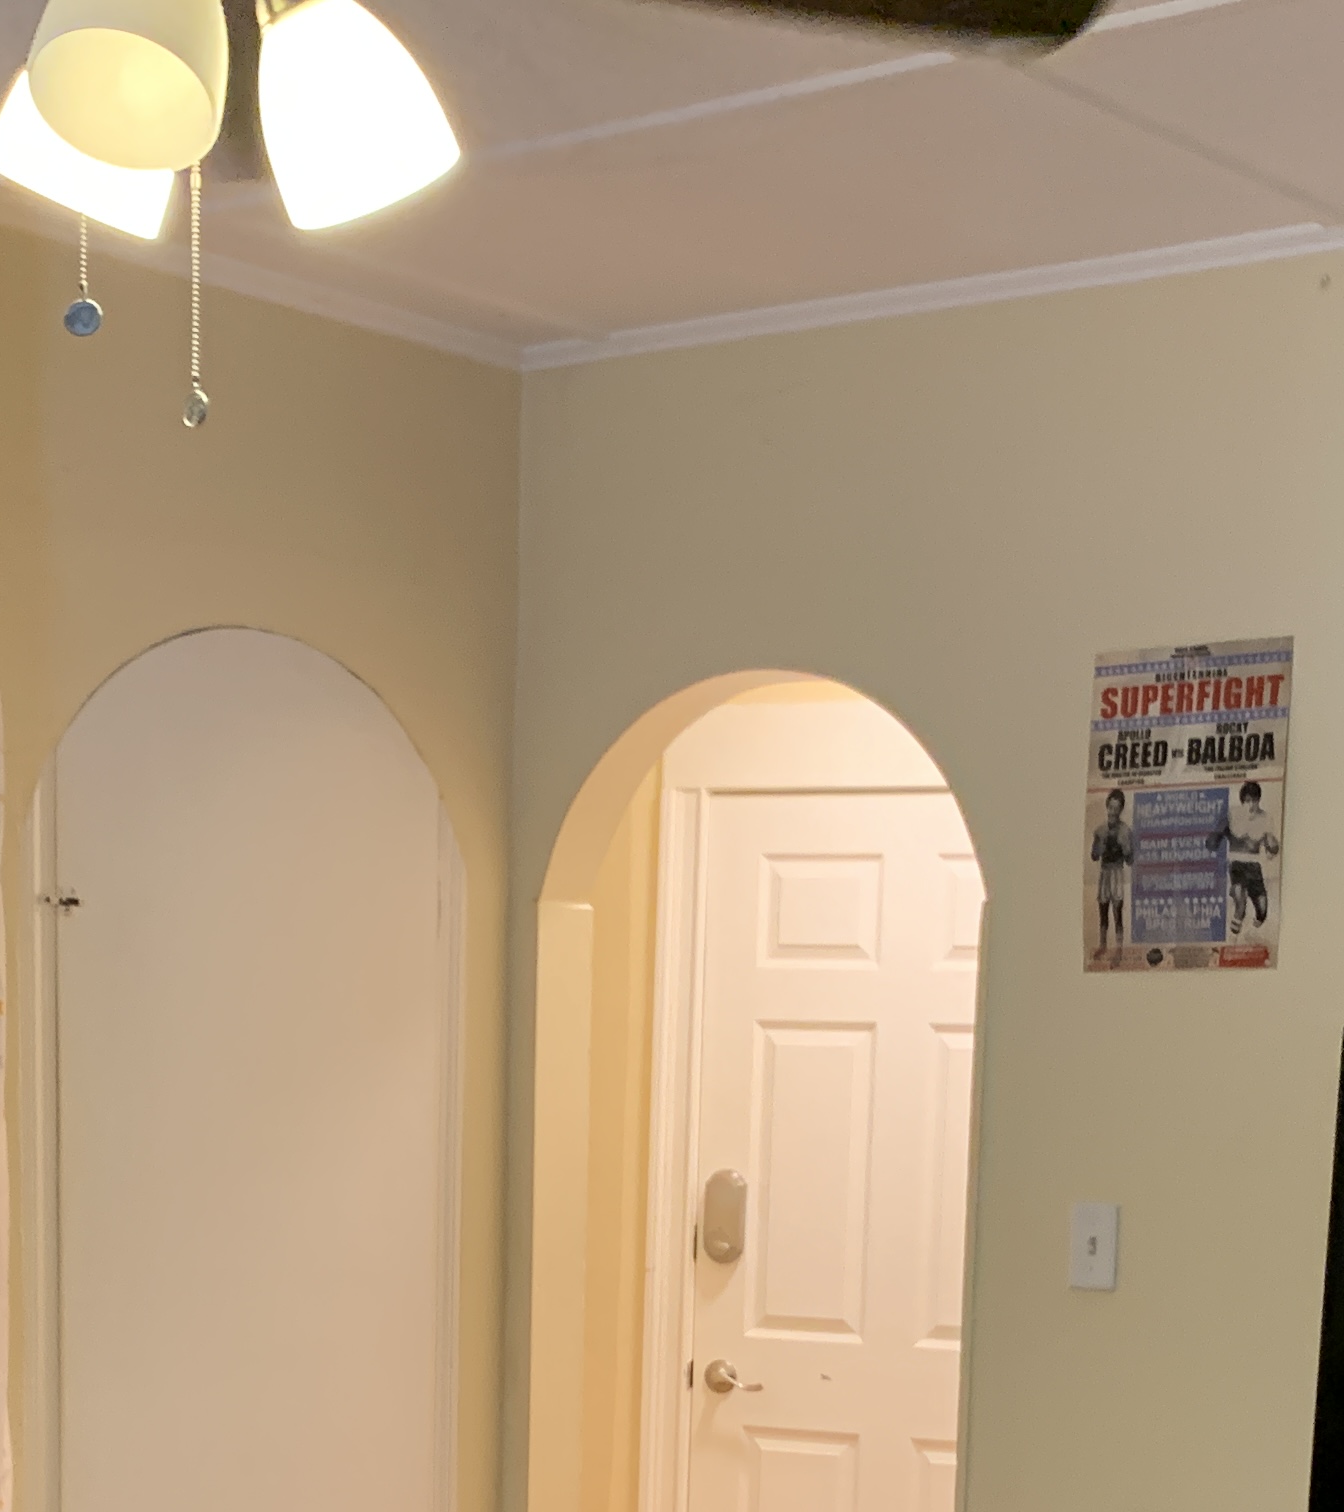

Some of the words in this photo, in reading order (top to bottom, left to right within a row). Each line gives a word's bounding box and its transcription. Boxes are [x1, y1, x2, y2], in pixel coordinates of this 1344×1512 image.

[1100, 674, 1285, 719] SUPERFIGHT
[1098, 740, 1168, 771] CREED
[1186, 732, 1275, 766] BALBOA
[1137, 800, 1224, 818] HEAVYWEIGHT
[1141, 839, 1168, 850] MAIN
